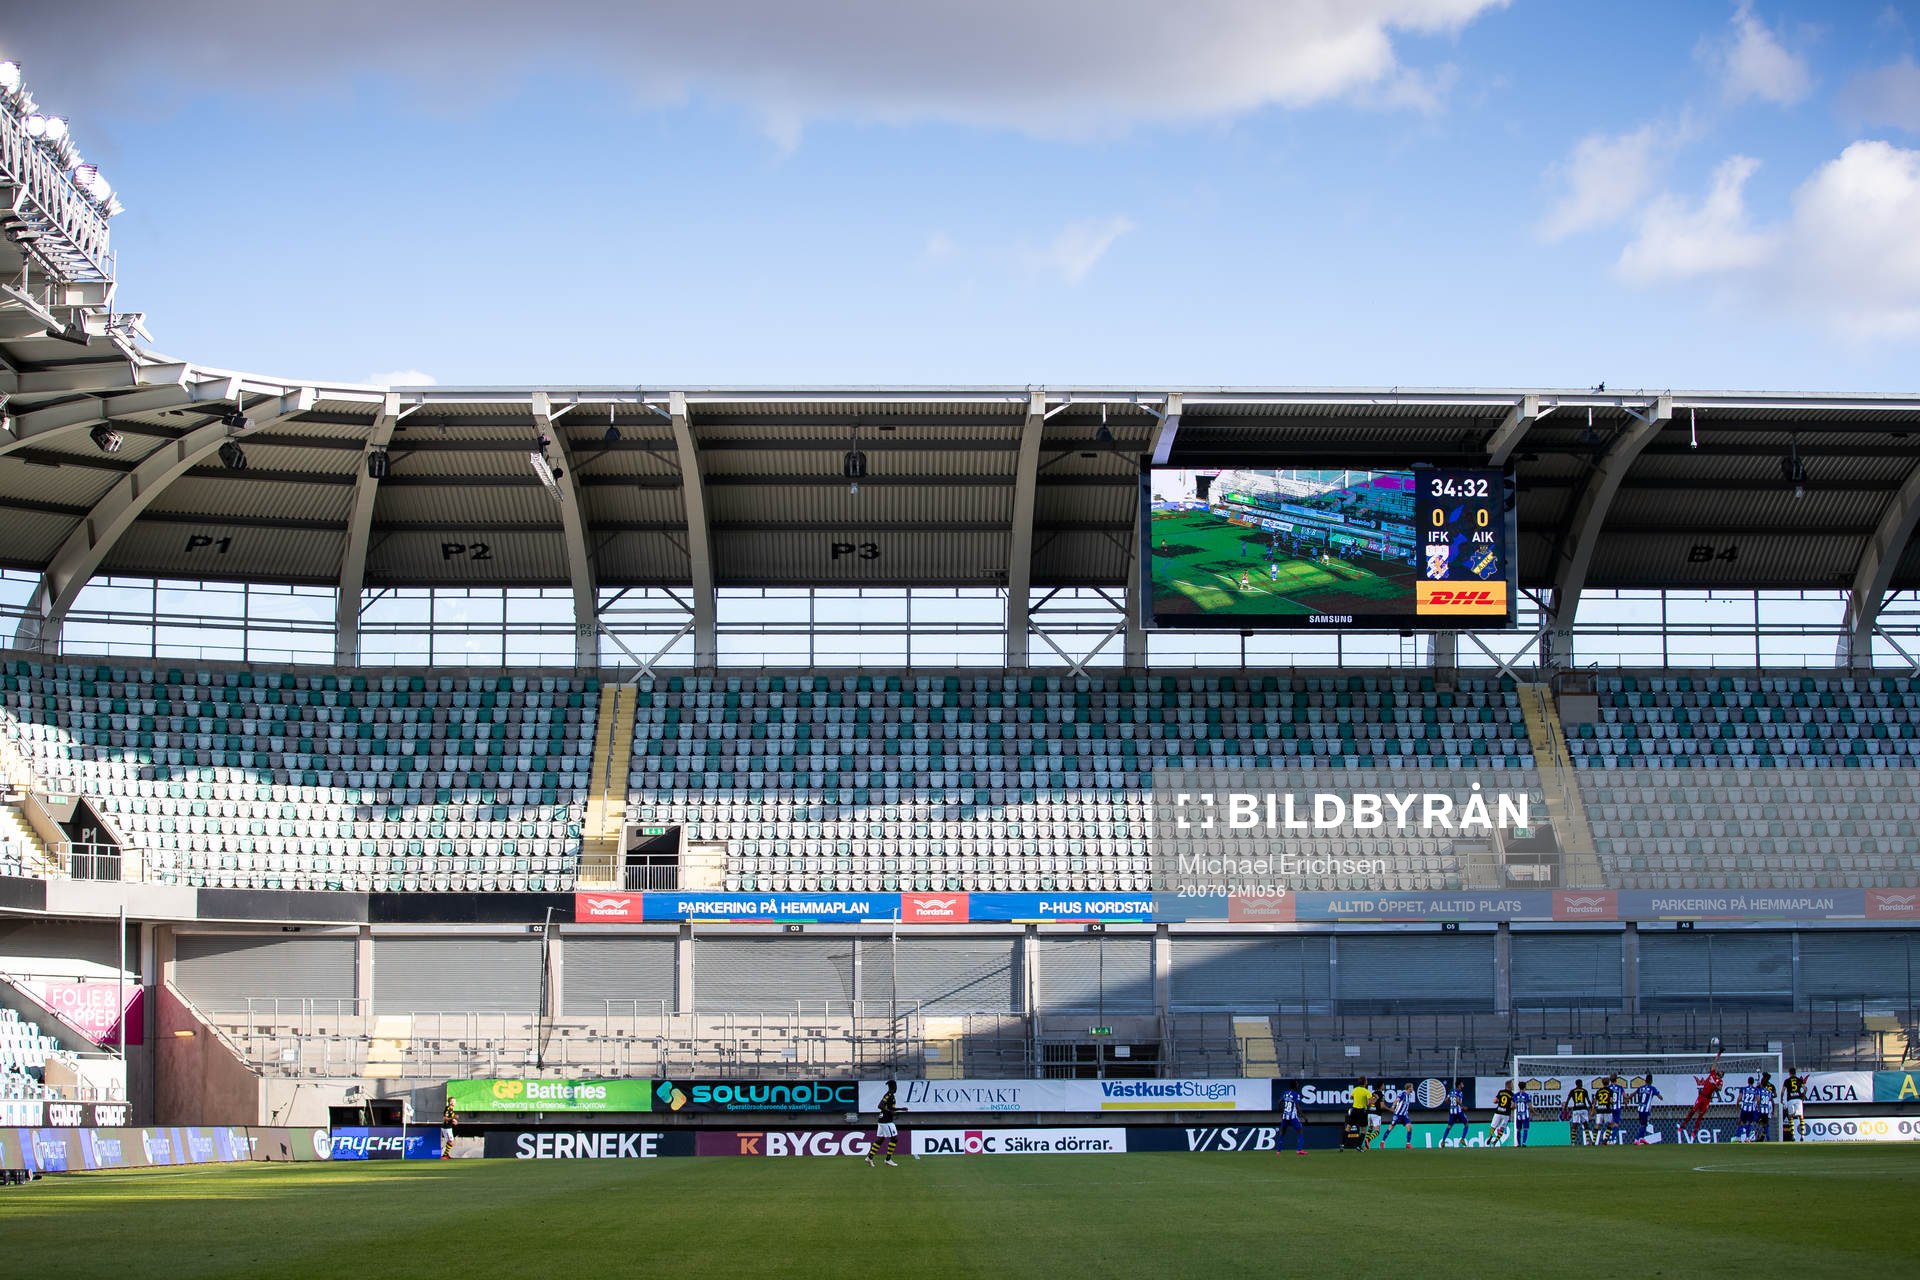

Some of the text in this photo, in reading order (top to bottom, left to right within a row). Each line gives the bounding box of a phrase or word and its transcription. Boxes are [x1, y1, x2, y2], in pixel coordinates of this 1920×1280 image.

[1431, 479, 1488, 497] 34:32
[1432, 508, 1489, 527] 0 0
[184, 534, 231, 554] P1
[1428, 531, 1494, 542] IFK AIK
[441, 542, 493, 561] P2
[831, 542, 880, 560] P3
[1687, 544, 1738, 562] B4
[1429, 591, 1494, 605] DHL
[1309, 615, 1353, 623] SAMSUNG
[82, 827, 97, 843] P1
[678, 898, 870, 914] PARKERING PÅ HEMMAPLAN
[1039, 901, 1160, 914] P-HUS NORDSTAN
[1327, 898, 1522, 915] ALLTID ÖPPET, ALLTID PLATS
[1652, 895, 1834, 911] PARKERING PÅ HEMMAPLAN
[493, 1080, 607, 1099] GP Batteries
[1101, 1081, 1237, 1100] VästkustStugan
[1791, 1081, 1798, 1092] 5
[1804, 1084, 1859, 1101] ASTA
[934, 1088, 1021, 1103] KONTAKT
[1575, 1092, 1584, 1103] 14
[1745, 1093, 1755, 1104] 22
[1517, 1101, 1526, 1113] 10
[515, 1133, 658, 1159] SERNEKE
[766, 1131, 872, 1156] BYGG
[925, 1135, 1113, 1153] DALOC Säkra dörrar.
[1185, 1127, 1276, 1152] V/S/B
